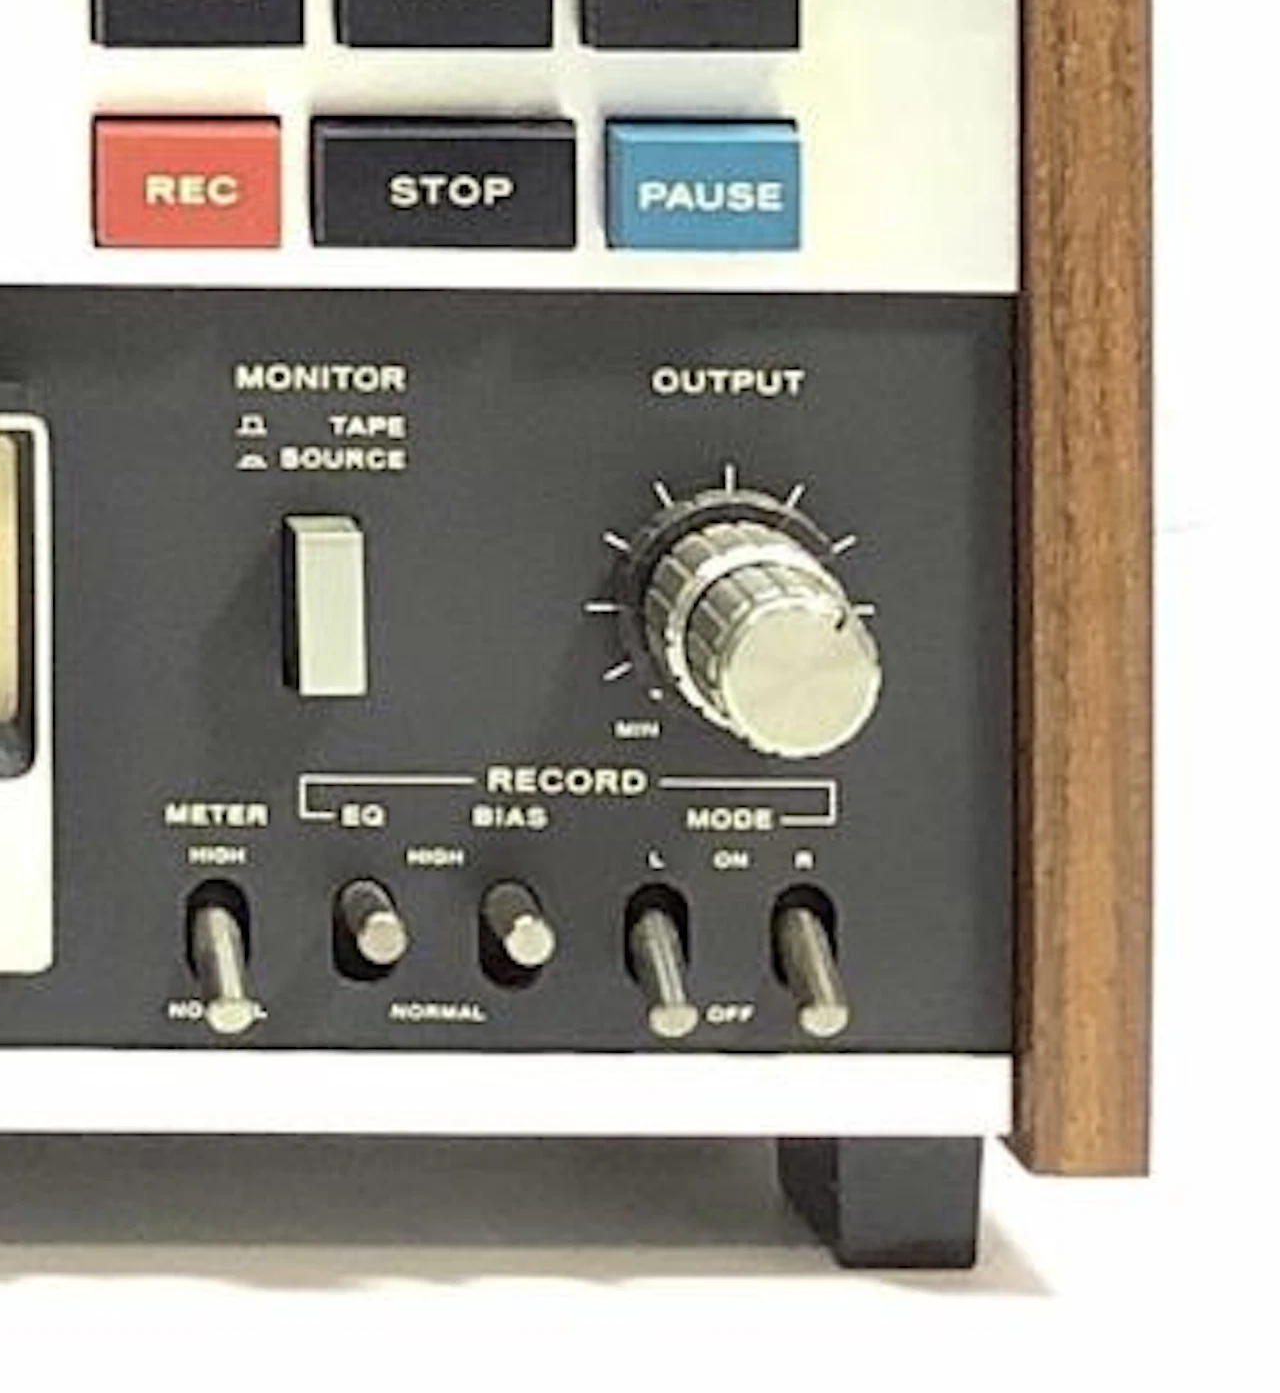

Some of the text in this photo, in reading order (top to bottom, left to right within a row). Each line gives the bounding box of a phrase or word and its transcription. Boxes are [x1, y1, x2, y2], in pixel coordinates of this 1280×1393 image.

[145, 174, 239, 206] REC
[390, 175, 514, 207] STOP
[640, 180, 784, 213] PAUSE
[236, 364, 406, 392] MONITOR
[651, 366, 805, 397] OUTPUT
[329, 416, 406, 438] TAPE
[279, 448, 407, 470] SOURCE
[615, 721, 661, 739] MIN
[487, 767, 648, 798] RECORD
[165, 804, 269, 826] METER
[342, 804, 385, 828] EQ
[472, 804, 549, 829] BIAS
[686, 806, 774, 831] MODE
[189, 846, 247, 866] HIGH
[406, 847, 465, 867] HIGH
[648, 850, 816, 870] L ON R
[389, 1003, 487, 1022] NORMAL
[706, 1003, 754, 1023] OFF
